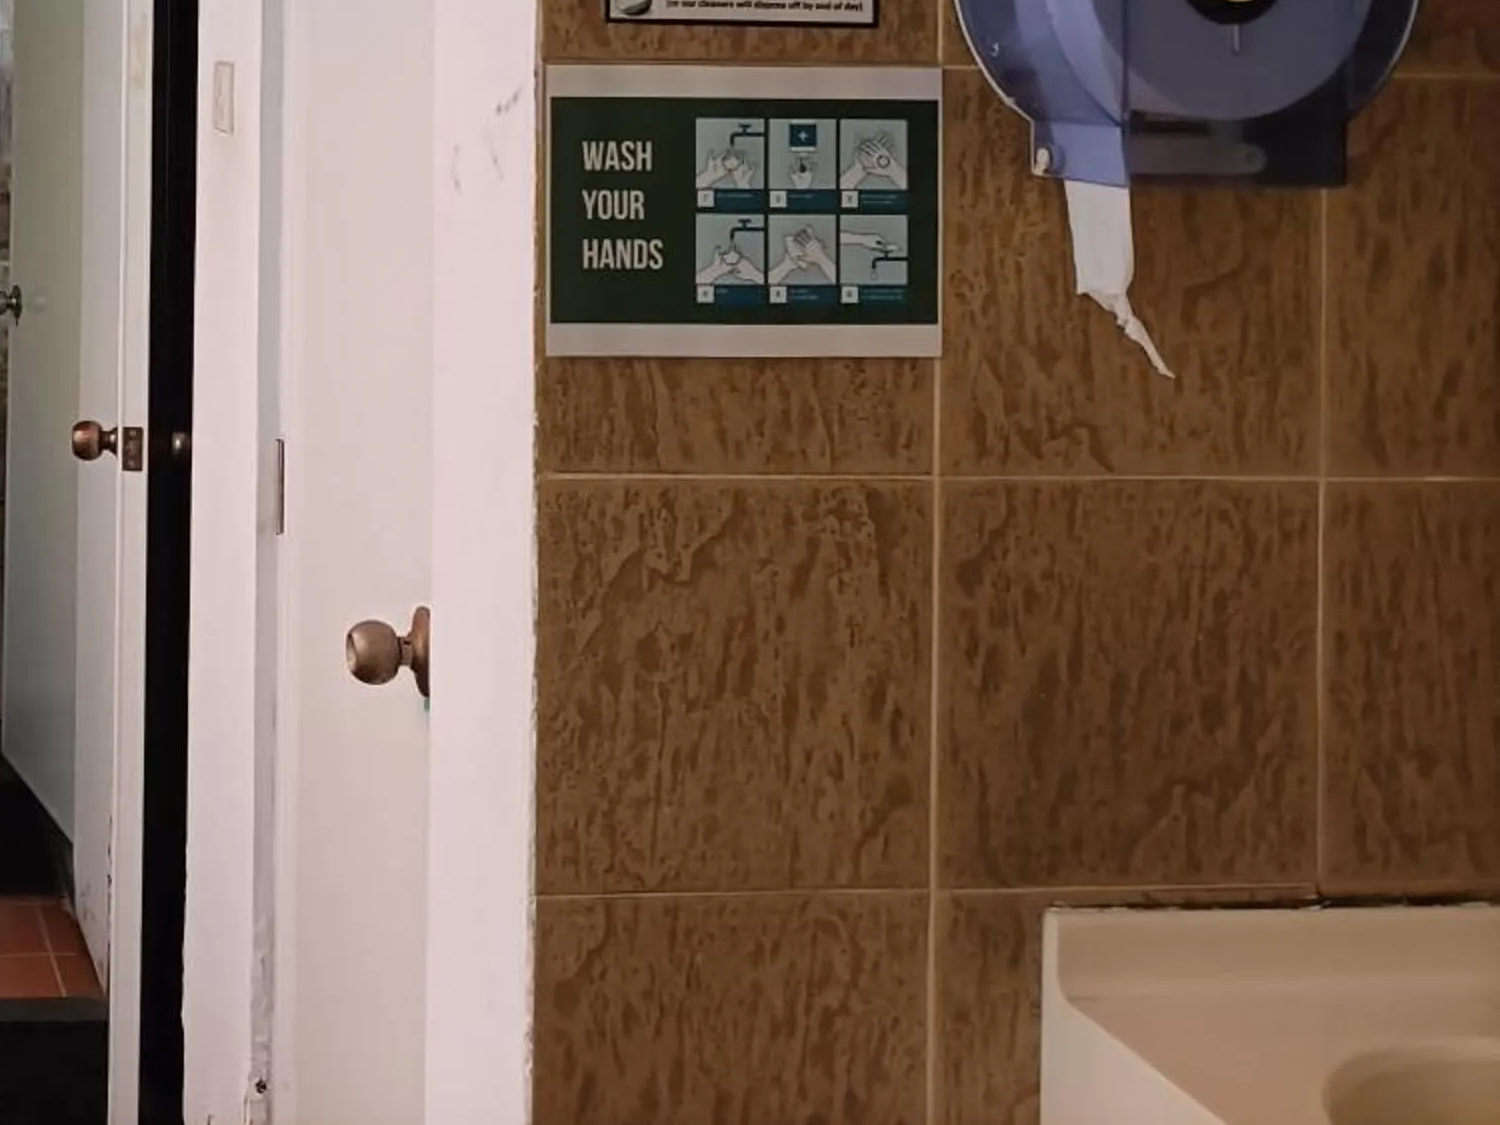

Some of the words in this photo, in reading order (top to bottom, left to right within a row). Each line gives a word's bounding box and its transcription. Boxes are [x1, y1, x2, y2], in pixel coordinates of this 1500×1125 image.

[582, 140, 653, 172] WASH
[581, 189, 645, 220] YOUR
[582, 238, 664, 270] HANDS
